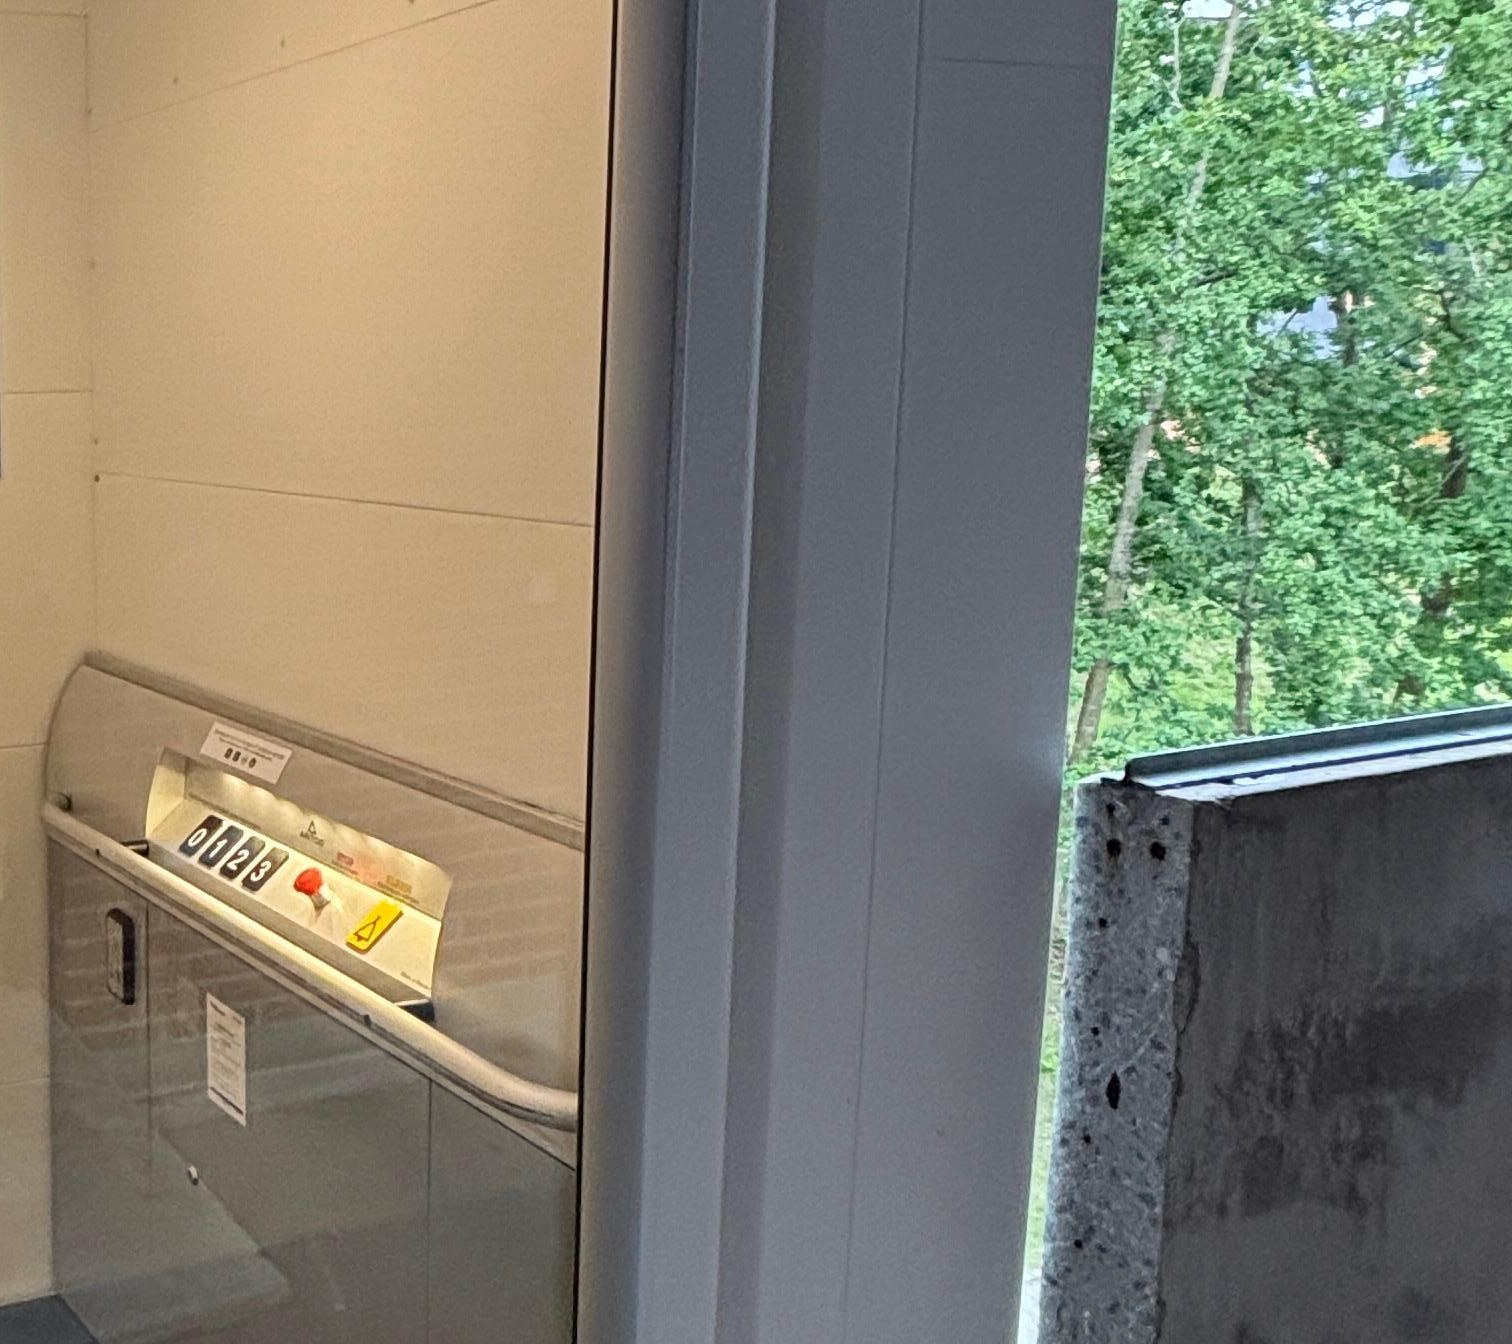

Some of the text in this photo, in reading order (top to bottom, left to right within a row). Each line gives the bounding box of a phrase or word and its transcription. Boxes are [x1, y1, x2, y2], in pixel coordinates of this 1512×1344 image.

[188, 828, 207, 847] 0
[209, 839, 227, 858] 1
[227, 849, 249, 870] 2
[251, 860, 272, 881] 3
